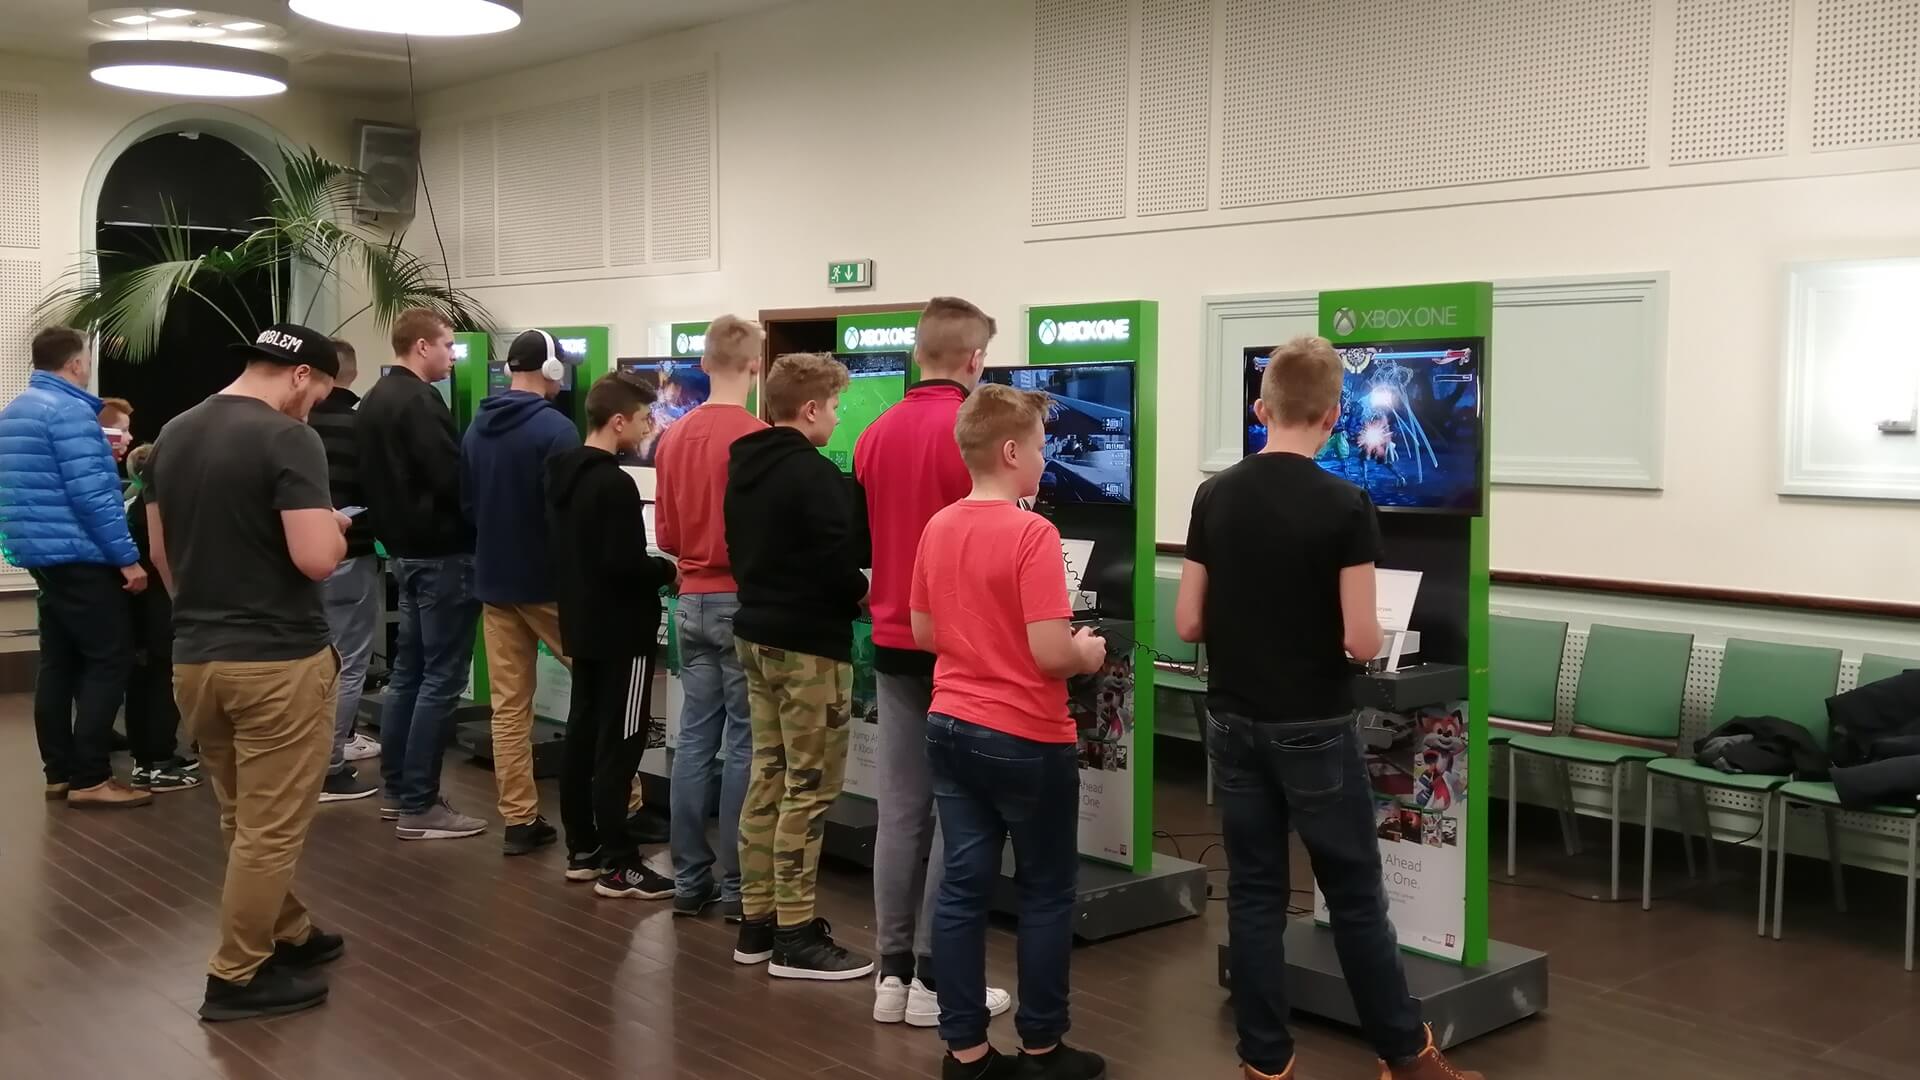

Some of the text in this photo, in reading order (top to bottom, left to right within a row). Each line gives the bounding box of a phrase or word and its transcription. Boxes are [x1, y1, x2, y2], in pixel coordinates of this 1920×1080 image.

[1360, 305, 1458, 329] XBOX ONE
[859, 326, 916, 346] XBOX ONE
[1057, 318, 1130, 341] XBOX ONE
[1384, 854, 1422, 873] Ahead
